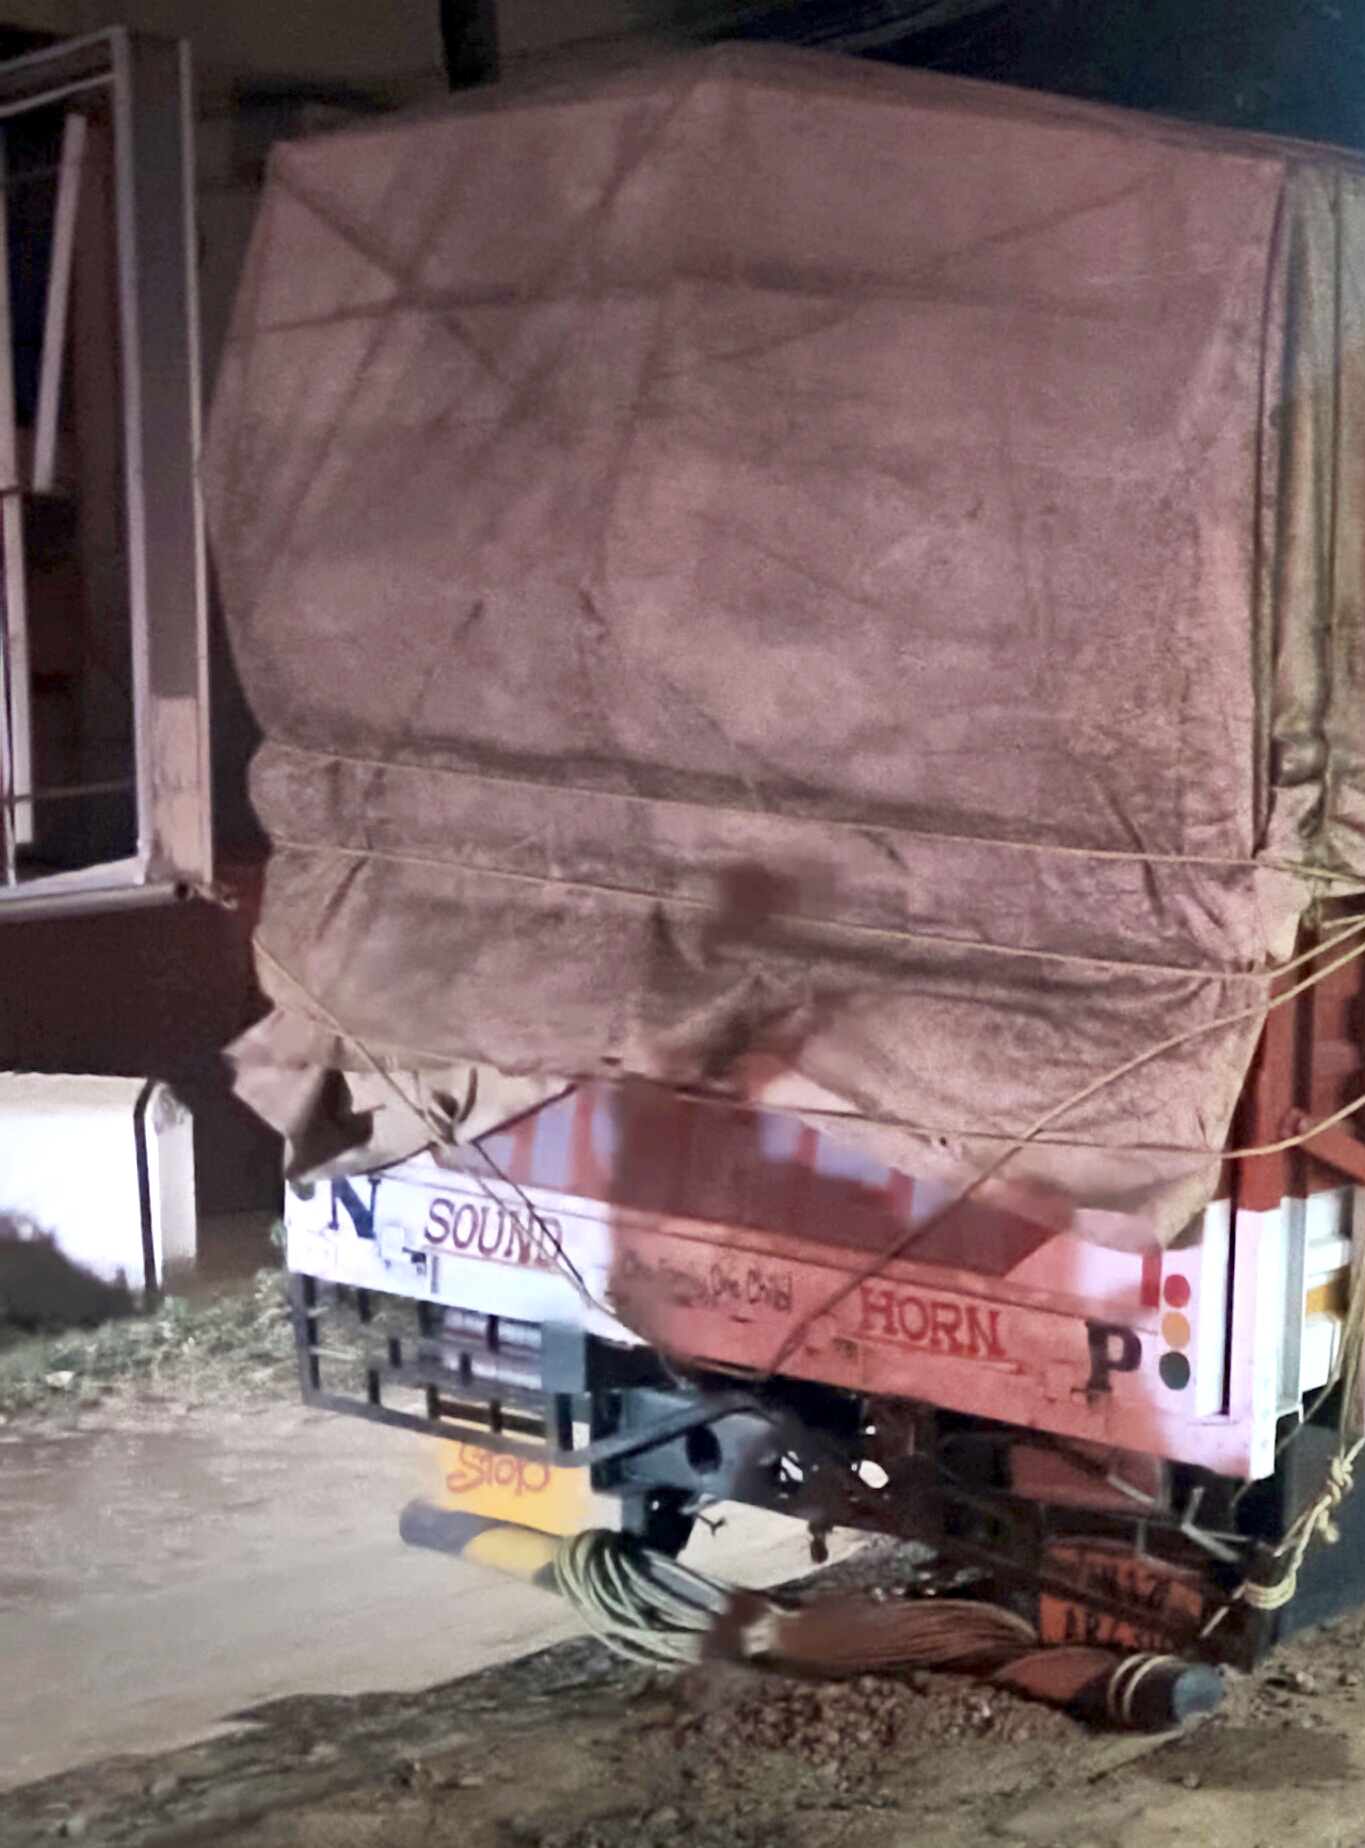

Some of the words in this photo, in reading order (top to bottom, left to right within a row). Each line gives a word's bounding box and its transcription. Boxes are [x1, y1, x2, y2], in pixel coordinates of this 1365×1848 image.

[327, 1176, 382, 1240] N
[424, 1197, 562, 1268] SOUND
[858, 1284, 1006, 1360] HORN
[1071, 1320, 1141, 1398] P
